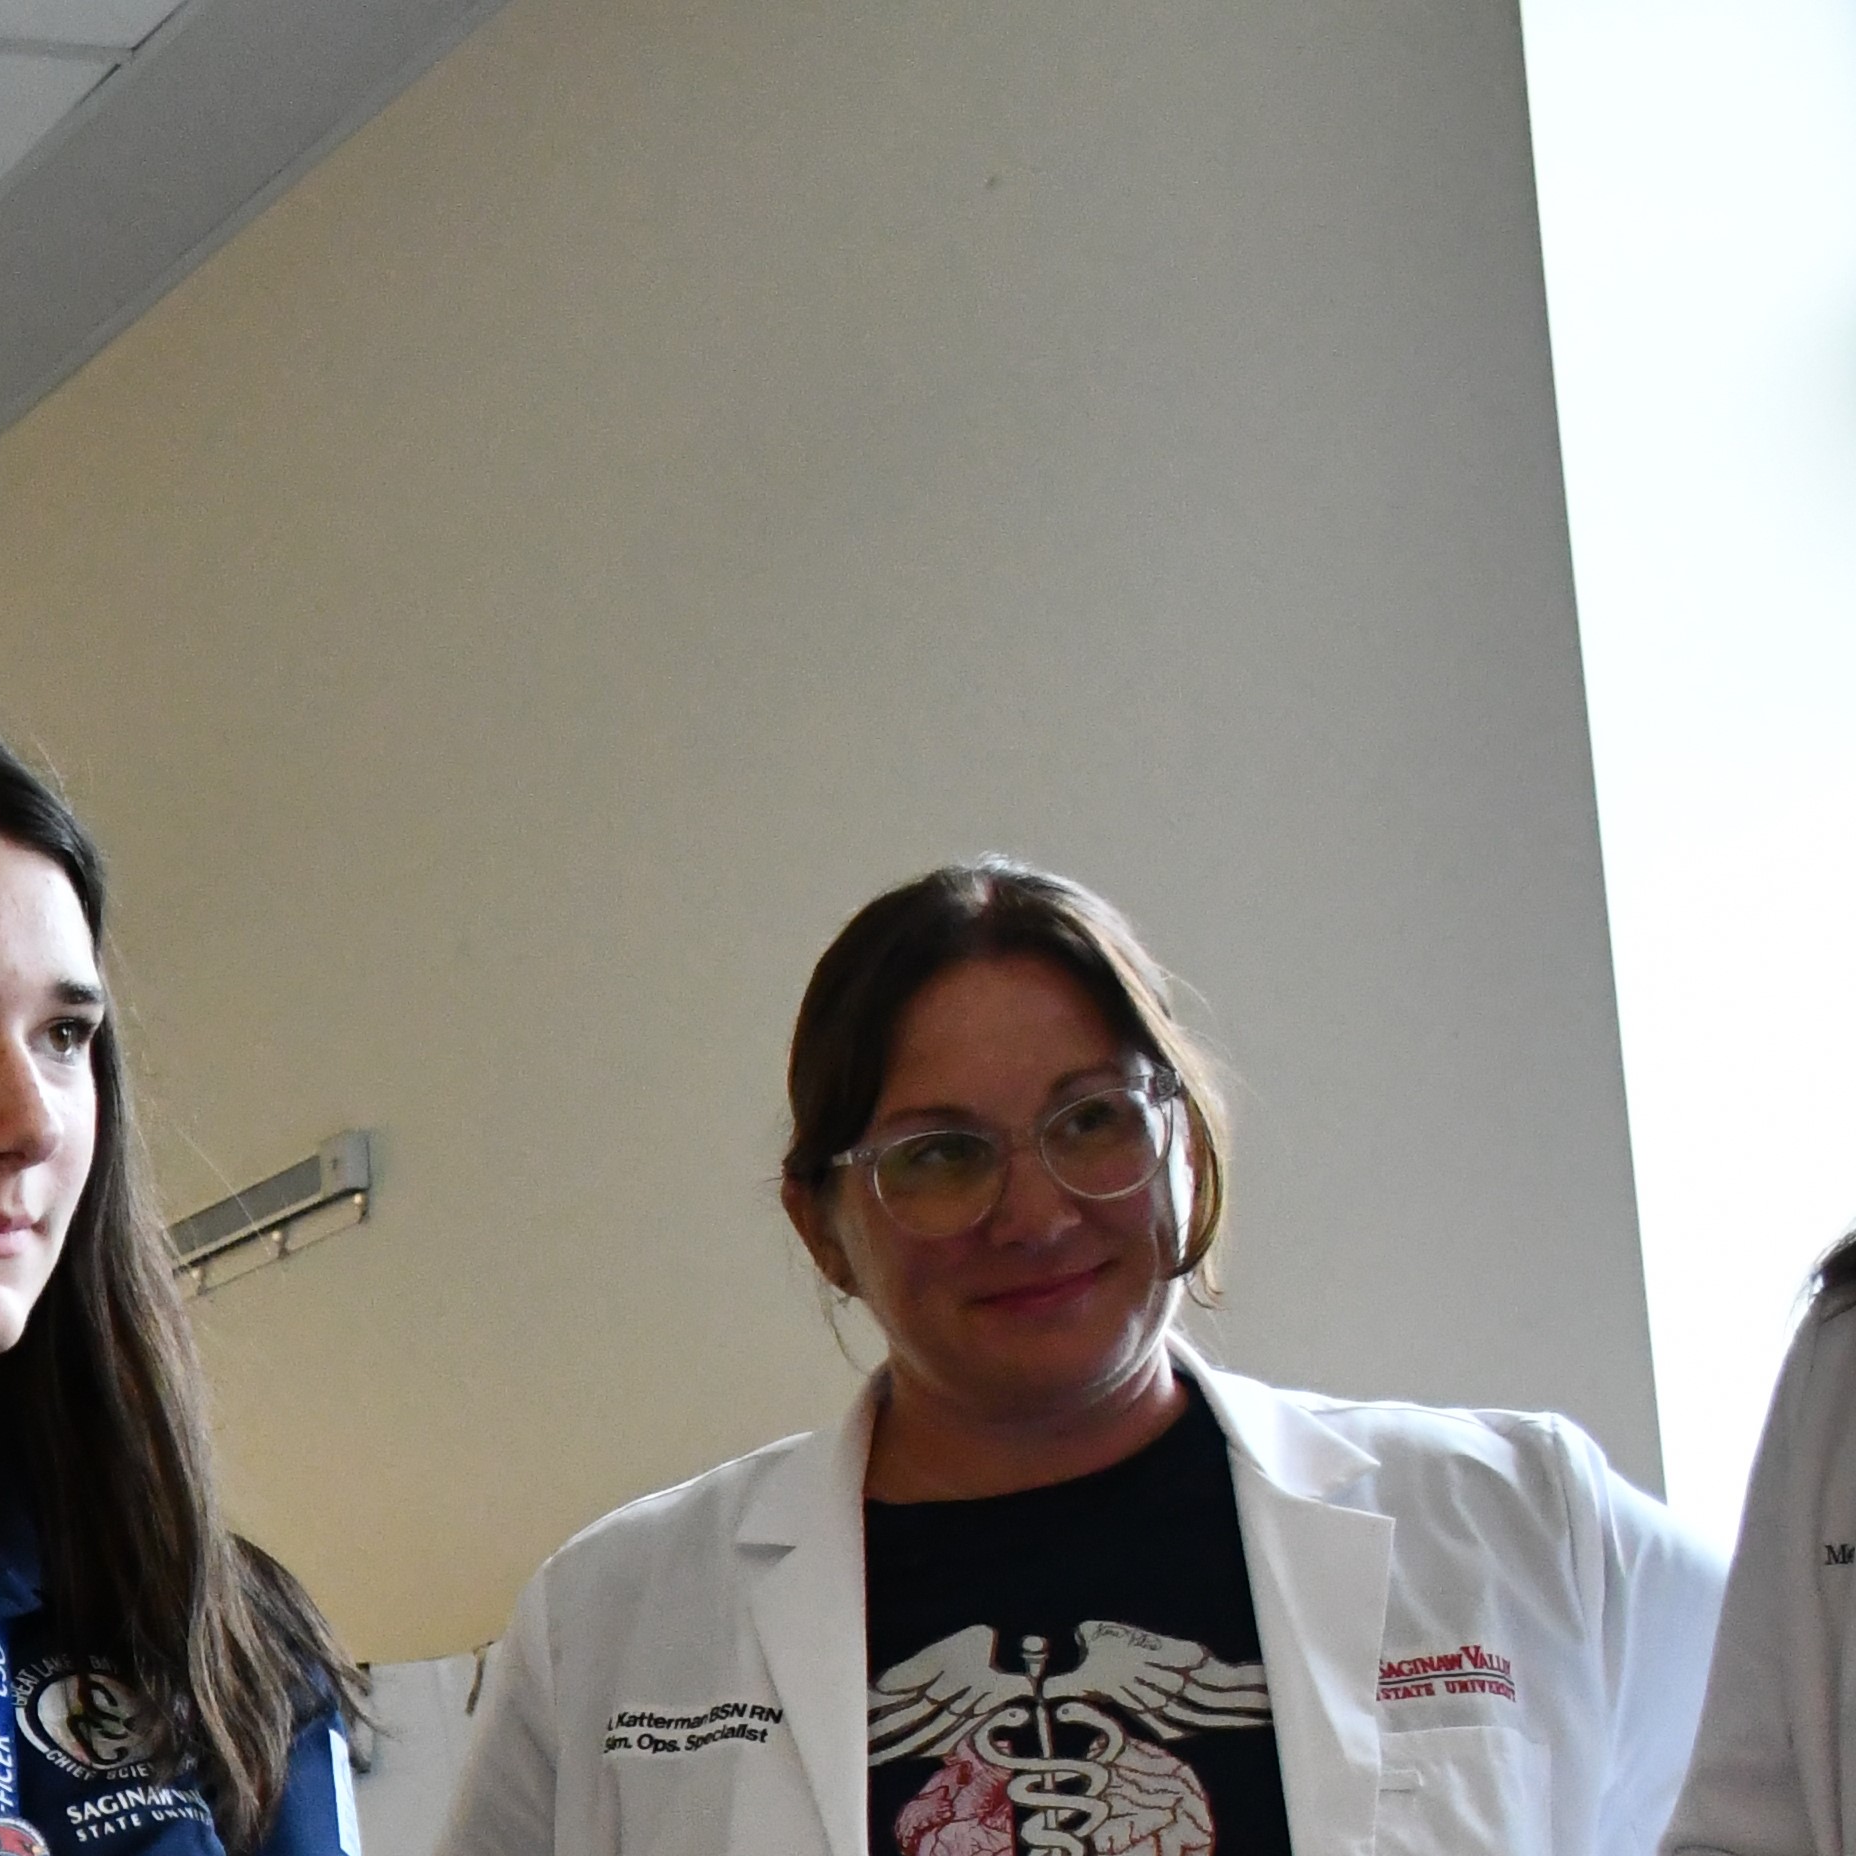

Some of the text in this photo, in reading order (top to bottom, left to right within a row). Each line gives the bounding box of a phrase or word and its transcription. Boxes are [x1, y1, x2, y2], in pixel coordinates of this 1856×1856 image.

[1378, 1682, 1436, 1701] STATE
[708, 1703, 748, 1724] BSN
[749, 1704, 784, 1725] RN
[637, 1733, 681, 1755] Ops.
[76, 1813, 142, 1844] STATE
